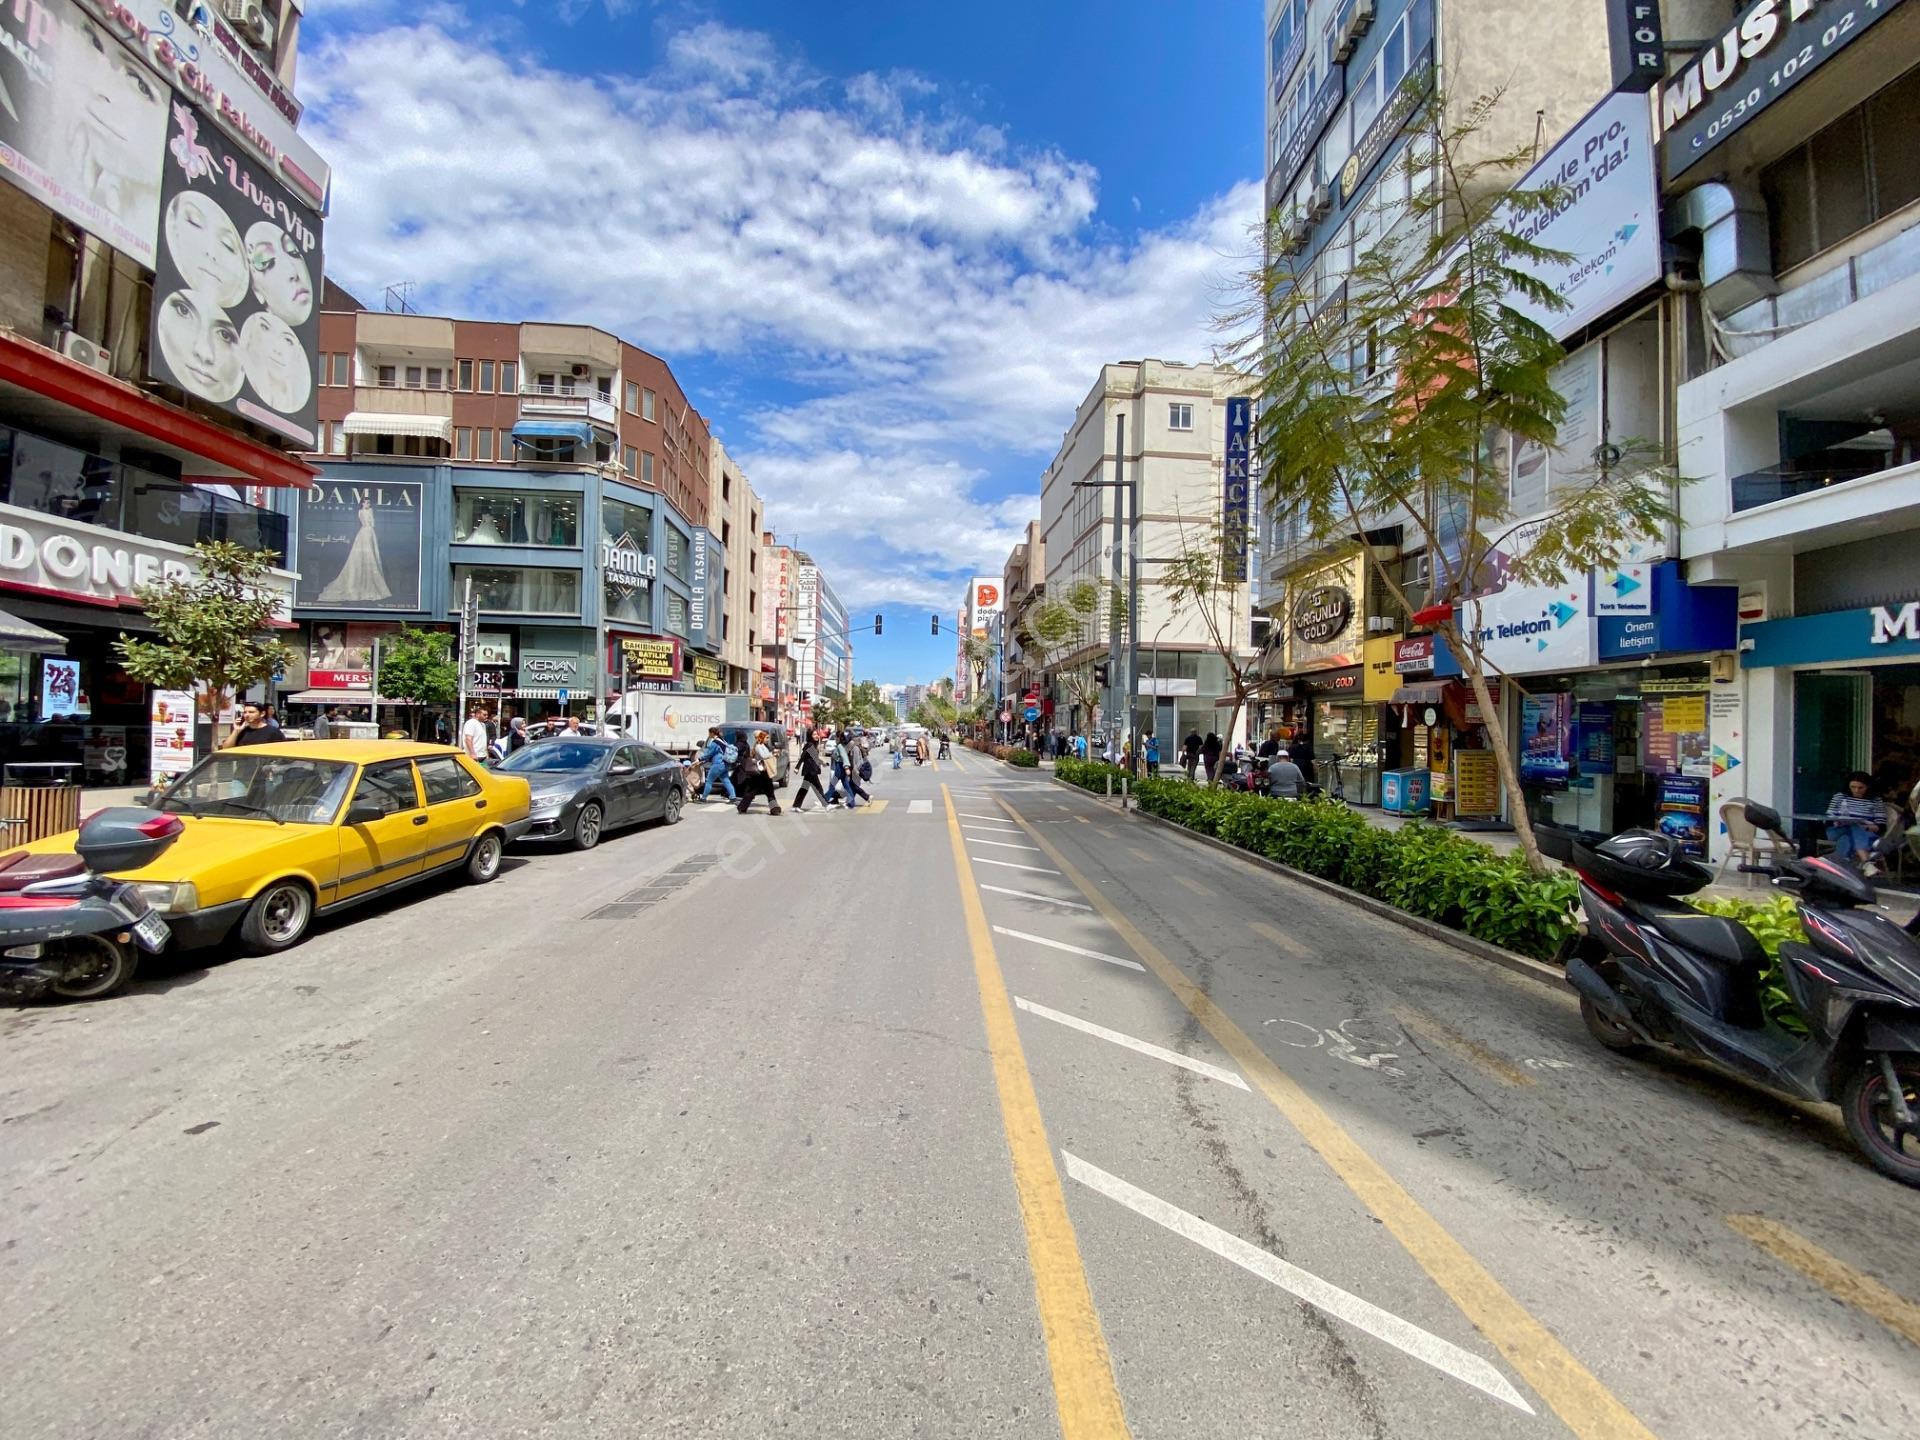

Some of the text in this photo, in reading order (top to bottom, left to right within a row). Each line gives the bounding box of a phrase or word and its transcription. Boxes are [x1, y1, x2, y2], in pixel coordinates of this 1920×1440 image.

[1707, 89, 1760, 140] 0530
[1768, 45, 1815, 87] 102
[1822, 12, 1855, 48] 02
[1584, 121, 1626, 163] Pro.
[223, 155, 315, 253] Liva Vip
[1568, 245, 1616, 286] Telekom
[306, 484, 415, 507] DAMLA
[606, 571, 648, 589] TASARIM
[691, 532, 705, 630] DAMLA TASARIM
[1304, 624, 1328, 640] GOLD
[1496, 619, 1551, 639] Telekom
[1625, 621, 1654, 633] Önem
[1620, 636, 1654, 650] İletişim
[679, 714, 721, 724] LOGISTICS
